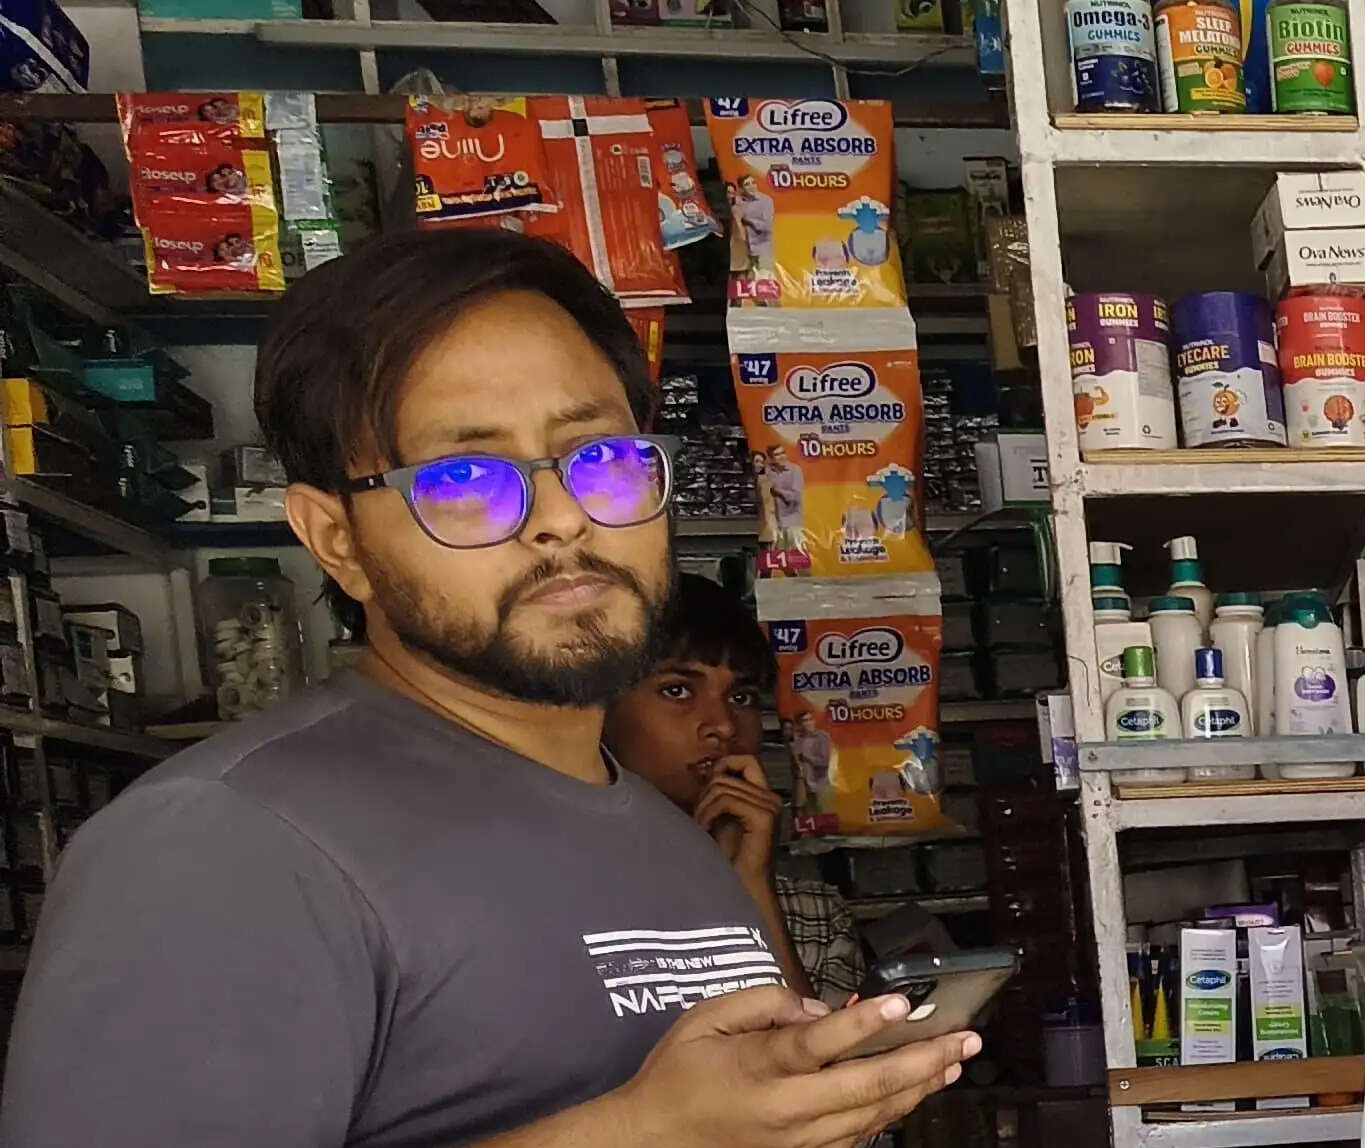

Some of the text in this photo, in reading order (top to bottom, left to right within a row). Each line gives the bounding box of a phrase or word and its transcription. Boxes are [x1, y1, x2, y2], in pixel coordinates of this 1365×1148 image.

[1073, 10, 1151, 28] Omega-3
[1196, 16, 1232, 32] SLEEP
[1088, 29, 1141, 43] GUMMIES
[1278, 20, 1345, 40] Biotin
[1287, 42, 1340, 55] GUMMIES
[769, 109, 833, 126] Lifree
[735, 137, 876, 154] EXTRA ABSORB
[771, 170, 847, 188] 10 HOURS
[1099, 303, 1138, 318] IRON
[1177, 346, 1230, 368] EYECARE
[1294, 354, 1326, 369] BRAIN
[799, 374, 862, 393] Lifree
[764, 404, 904, 421] EXTRA ABSORB
[801, 440, 876, 456] 10 HOURS
[828, 640, 891, 659] Lifree
[793, 665, 931, 690] EXTRA ABSORB
[829, 705, 904, 721] 10 HOURS
[1189, 975, 1227, 988] Cetaphil
